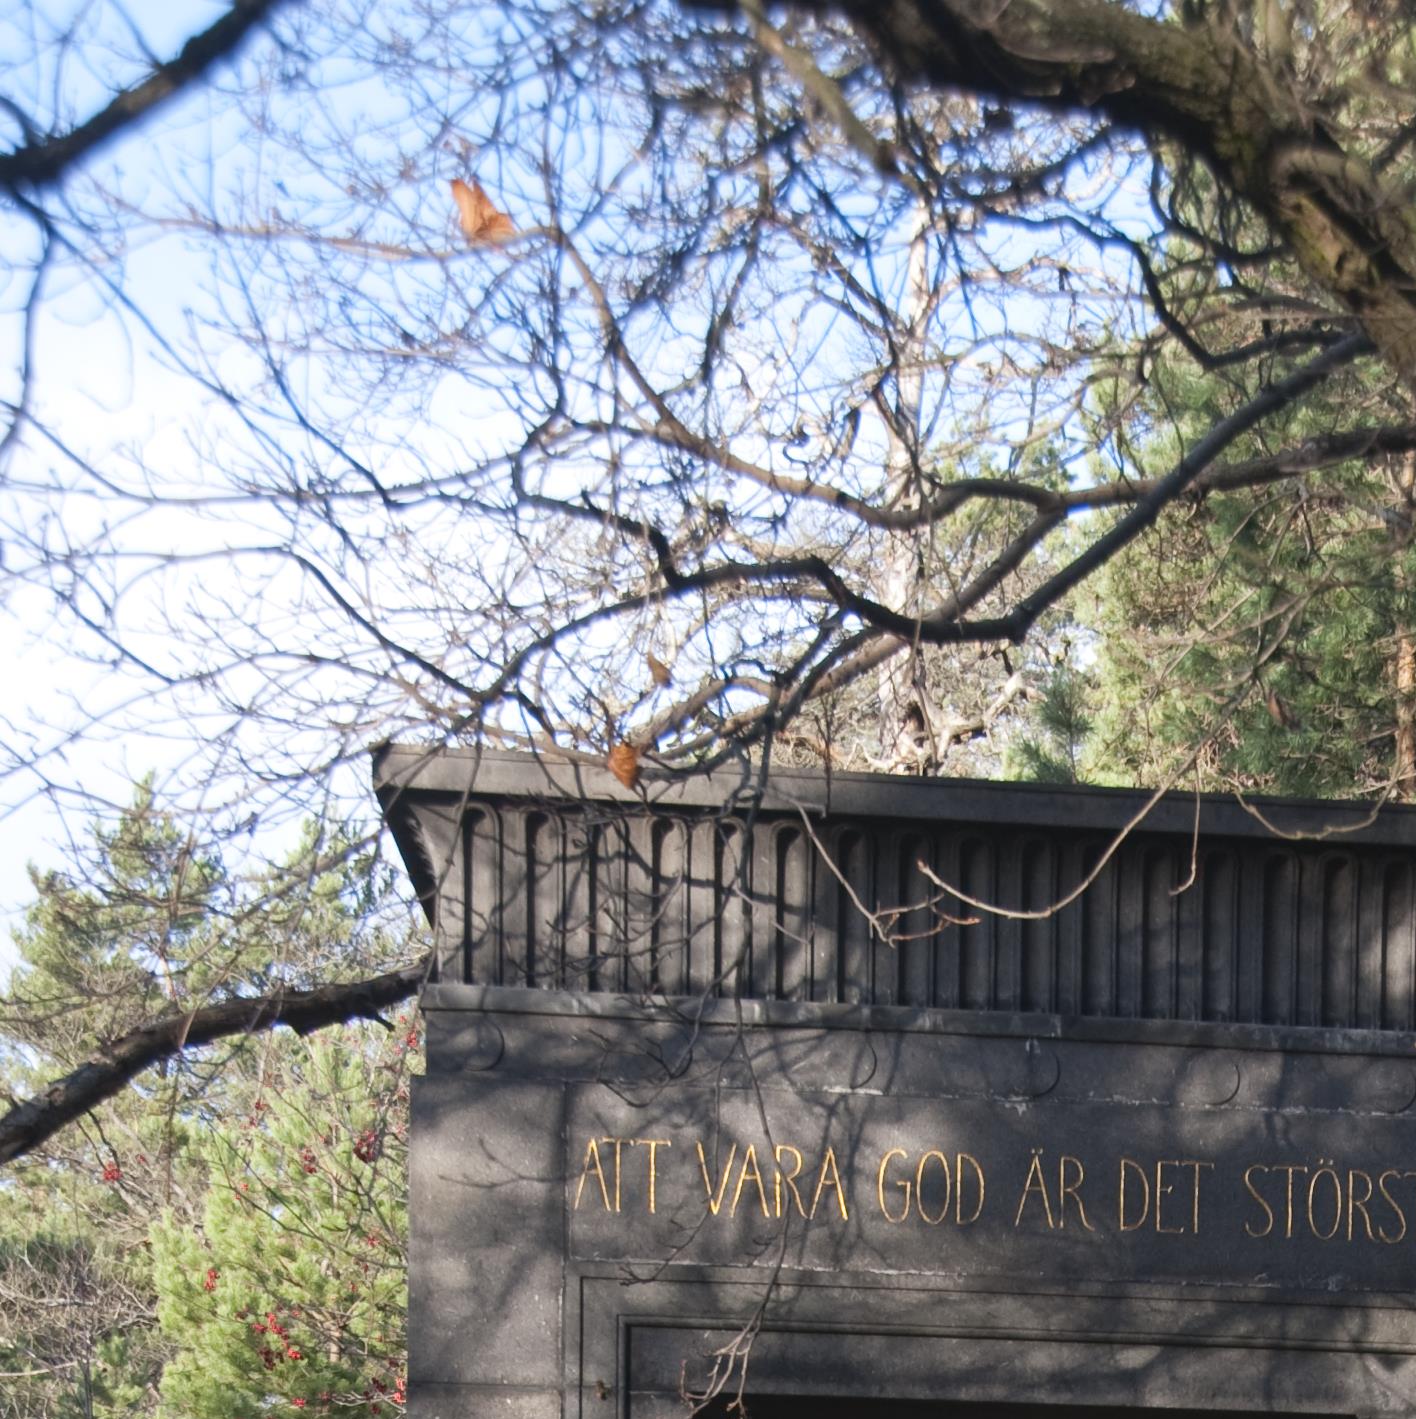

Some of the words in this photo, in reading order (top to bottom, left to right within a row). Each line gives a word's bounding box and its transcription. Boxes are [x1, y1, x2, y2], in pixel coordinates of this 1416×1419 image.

[574, 1137, 671, 1214] ATT
[696, 1140, 849, 1220] VARA
[877, 1147, 985, 1225] GOD
[1015, 1147, 1095, 1231] ÄR
[1119, 1158, 1215, 1233] DET
